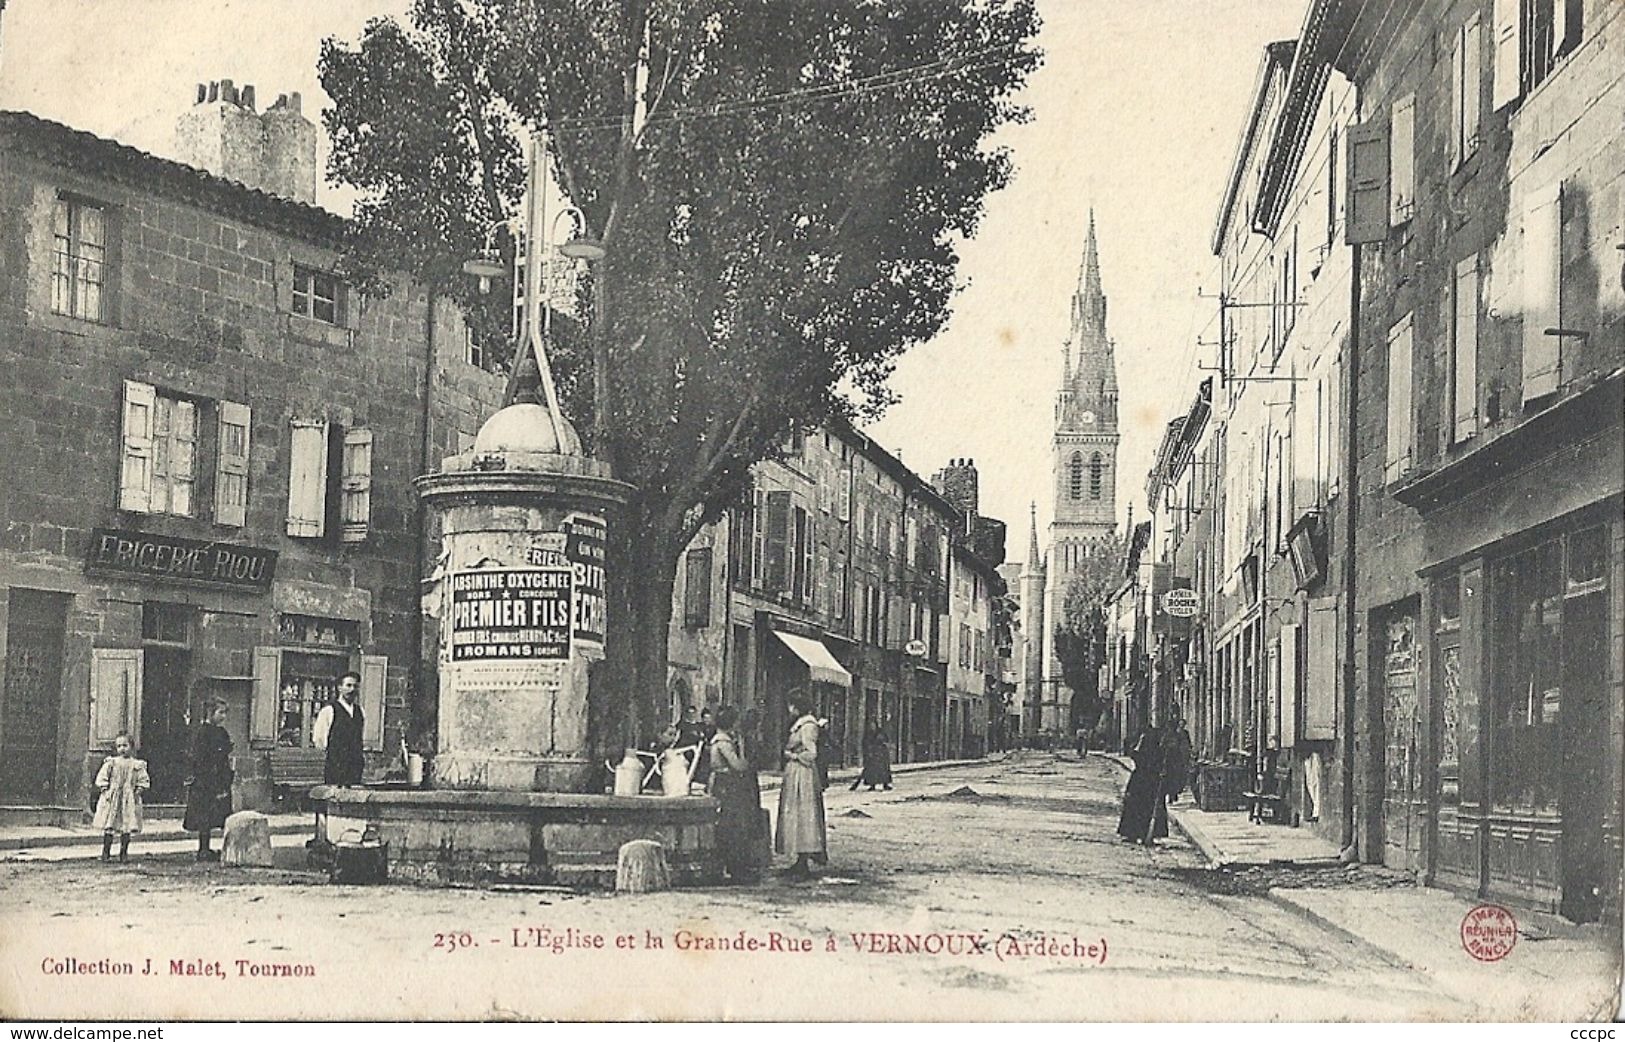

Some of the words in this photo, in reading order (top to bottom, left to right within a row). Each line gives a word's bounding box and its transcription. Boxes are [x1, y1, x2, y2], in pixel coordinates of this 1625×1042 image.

[212, 550, 266, 581] RIOU
[454, 573, 504, 590] ABSINTHE
[454, 600, 526, 629] PREMIER
[532, 599, 568, 626] FILS
[464, 645, 531, 656] ROMANS
